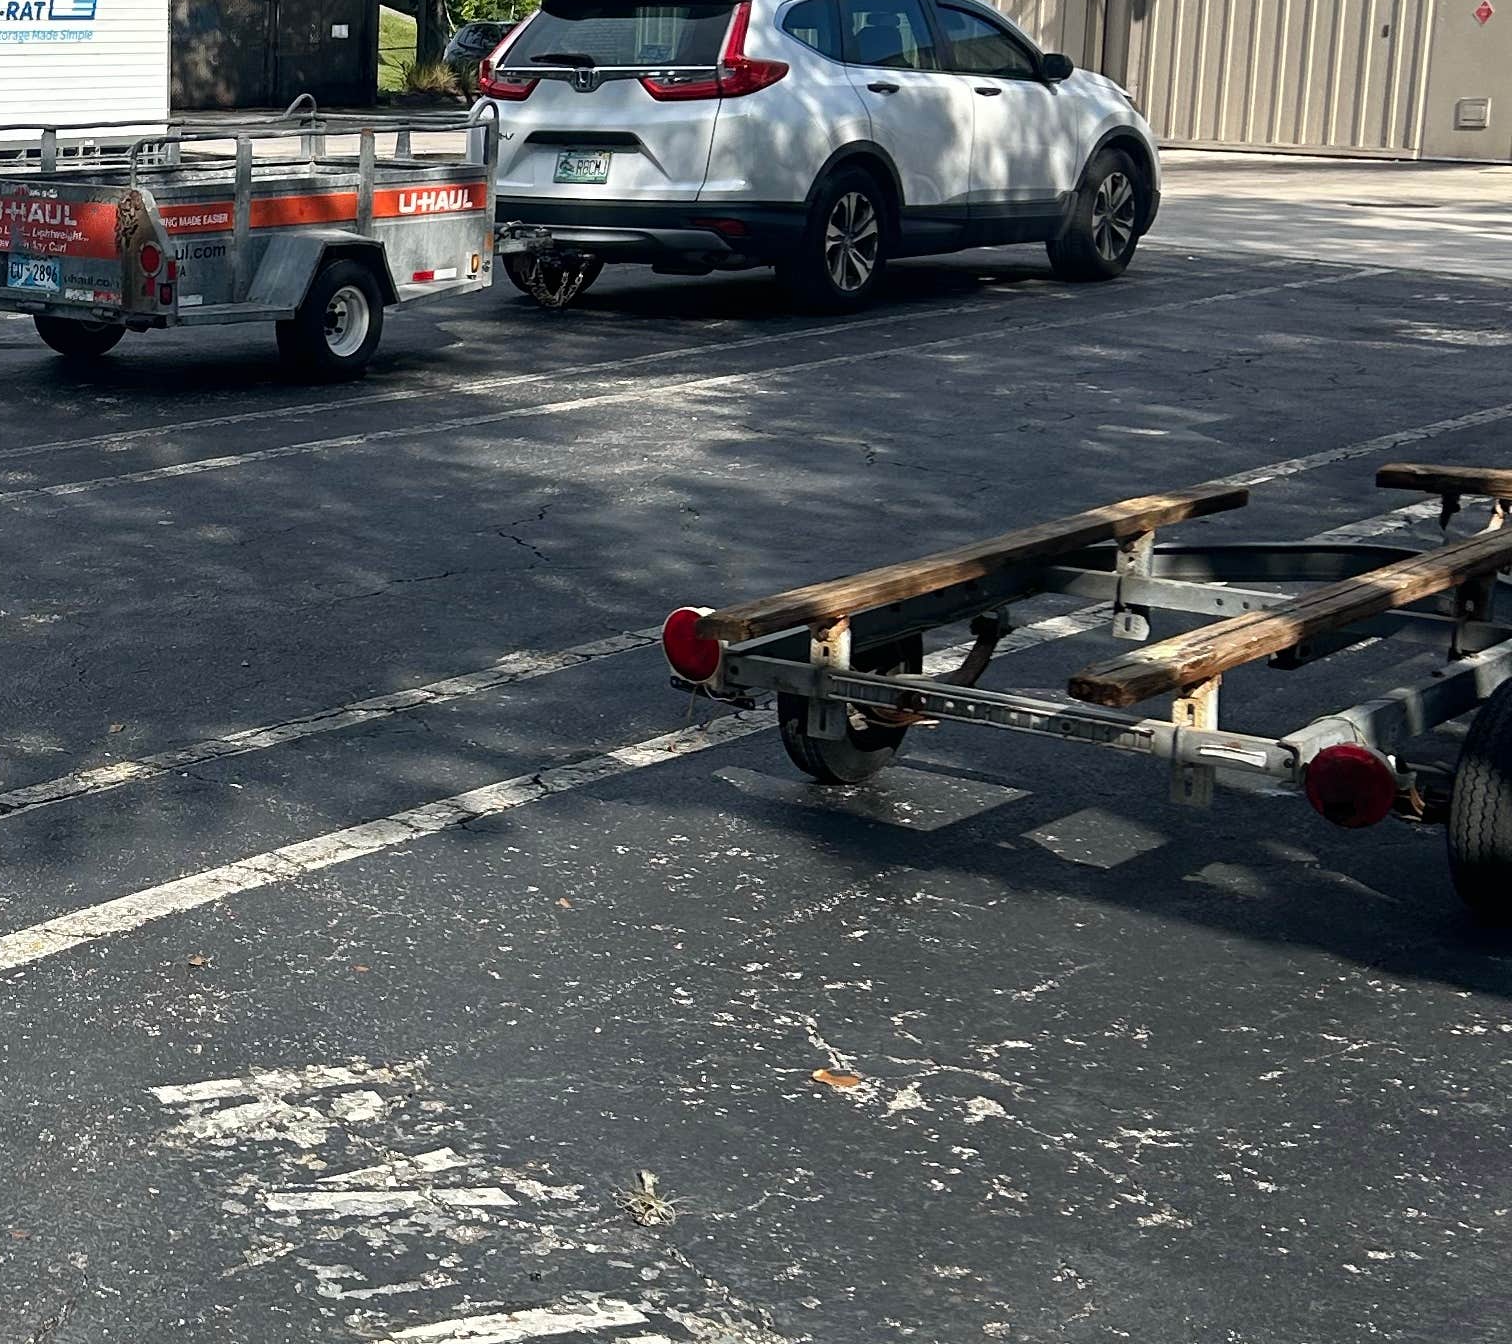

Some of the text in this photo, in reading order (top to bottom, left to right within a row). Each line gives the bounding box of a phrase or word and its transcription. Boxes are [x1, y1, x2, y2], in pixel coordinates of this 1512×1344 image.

[31, 30, 58, 41] Made
[60, 29, 93, 43] Simple
[399, 189, 473, 213] U-HAUL
[179, 215, 201, 226] MADE
[203, 213, 228, 225] EASIER
[175, 244, 226, 260] ul.com
[33, 264, 57, 282] 2896
